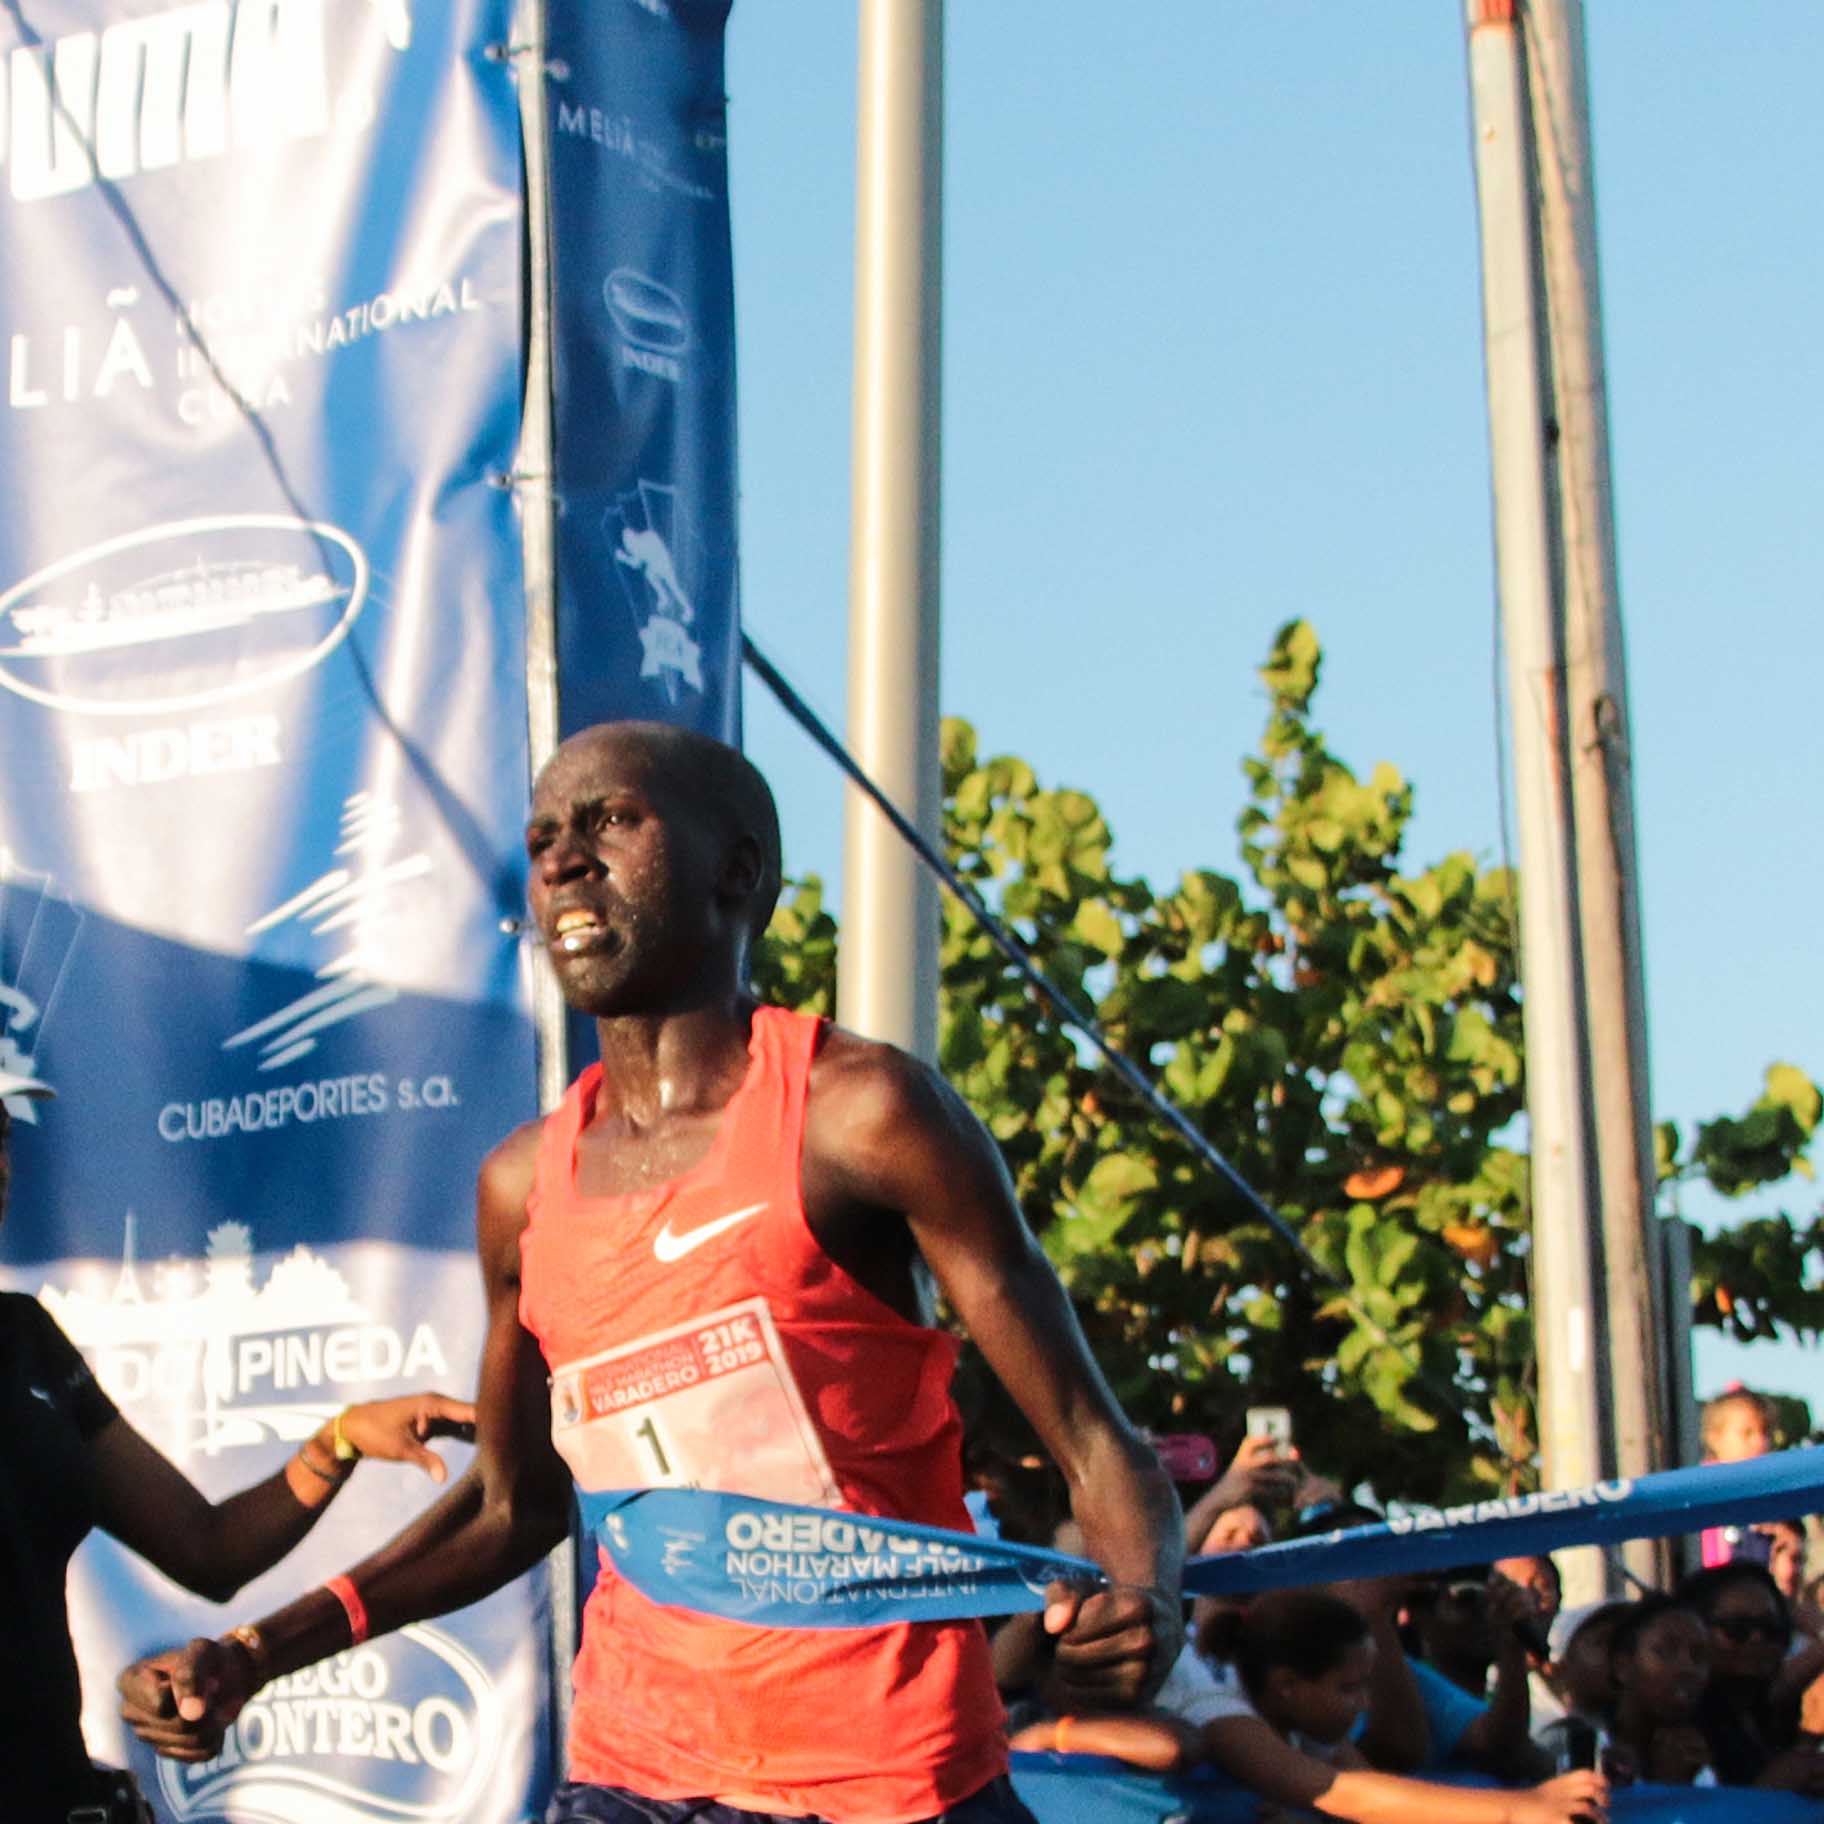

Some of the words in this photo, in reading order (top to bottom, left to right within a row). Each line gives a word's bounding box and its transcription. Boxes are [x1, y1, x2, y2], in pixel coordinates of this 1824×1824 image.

[176, 278, 480, 382] INNATIONAL
[69, 715, 282, 793] INDER
[156, 1073, 388, 1145] CUBADEPORTES
[238, 1322, 448, 1394] PINEDA
[698, 1313, 757, 1354] 21K
[705, 1340, 763, 1375] 2019
[593, 1366, 699, 1413] VARADERO
[637, 1418, 670, 1475] 1
[727, 1552, 897, 1579] MARATHON
[211, 1697, 473, 1775] ONTERO
